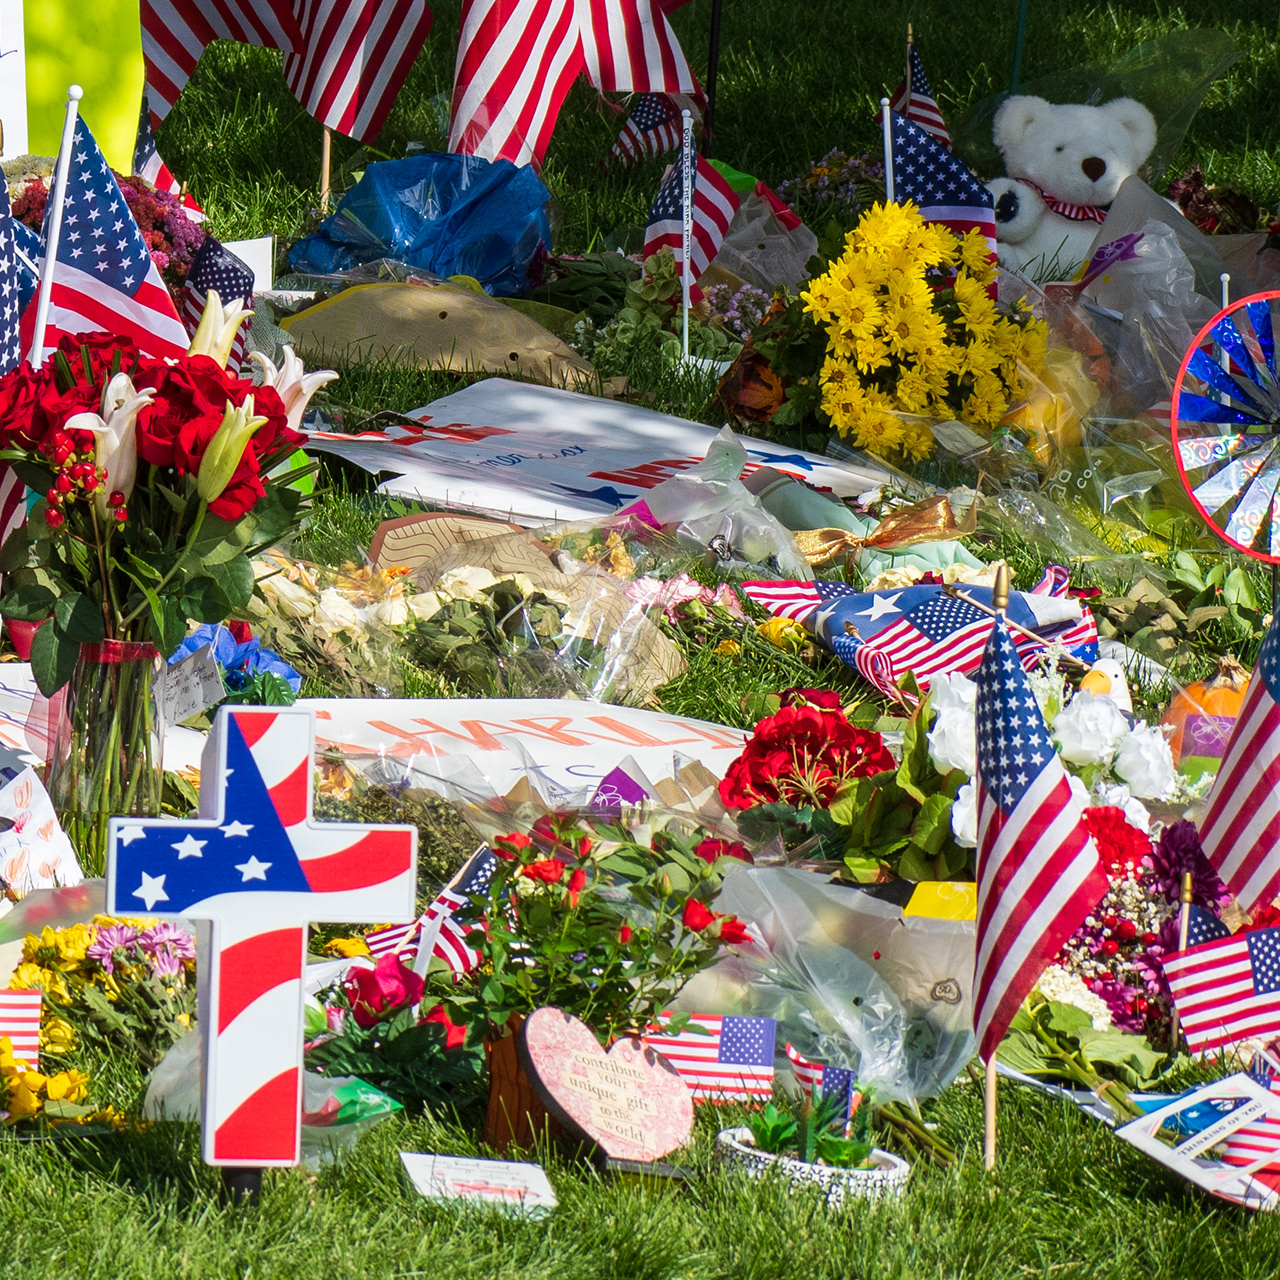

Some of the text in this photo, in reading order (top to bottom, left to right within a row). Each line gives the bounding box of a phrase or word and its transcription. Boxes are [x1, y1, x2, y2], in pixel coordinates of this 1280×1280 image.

[315, 710, 743, 757] CHARLI
[574, 1053, 646, 1081] contribute
[596, 1071, 628, 1090] your
[569, 1076, 650, 1113] unique gift
[599, 1105, 633, 1122] to the
[1177, 1102, 1263, 1156] THINKING OF YOU
